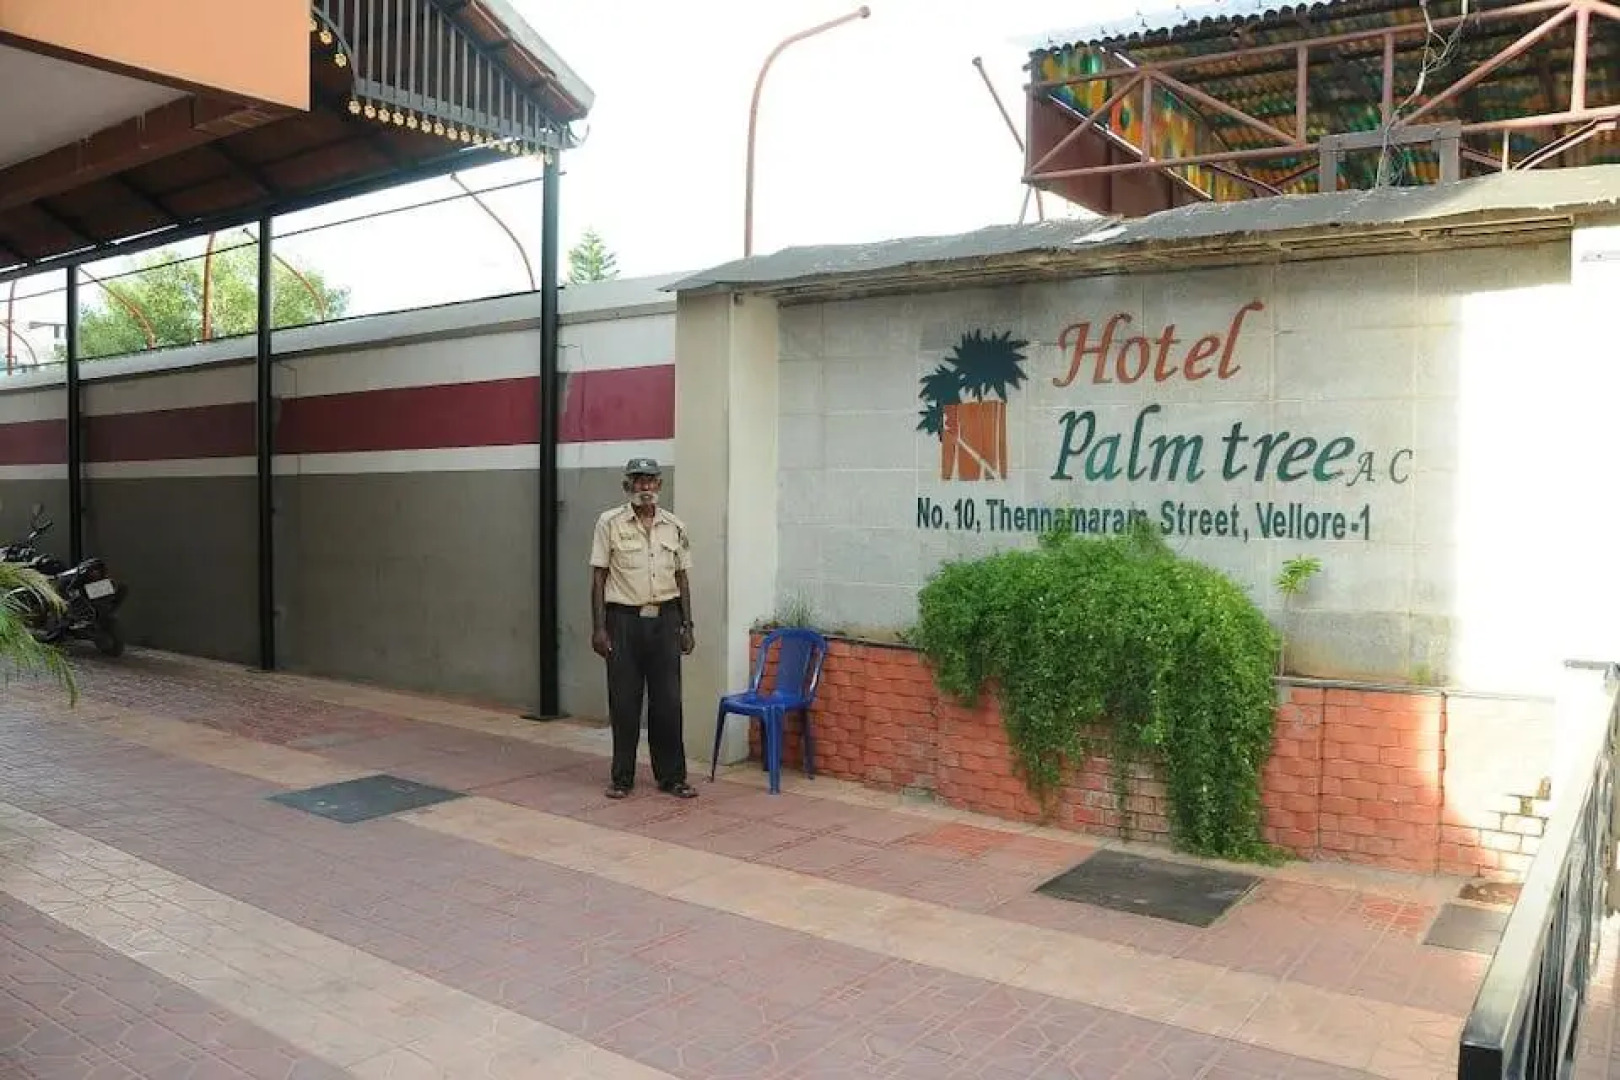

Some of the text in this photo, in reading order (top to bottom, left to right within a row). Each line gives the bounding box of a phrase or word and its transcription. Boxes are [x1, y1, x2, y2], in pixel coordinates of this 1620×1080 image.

[1053, 300, 1263, 387] Hotel
[1050, 404, 1204, 482] Palm
[1221, 421, 1356, 482] tree
[917, 497, 949, 529] No.
[954, 497, 981, 534] 10,
[1160, 500, 1248, 542] Street,
[1256, 502, 1371, 541] Vellore-1
